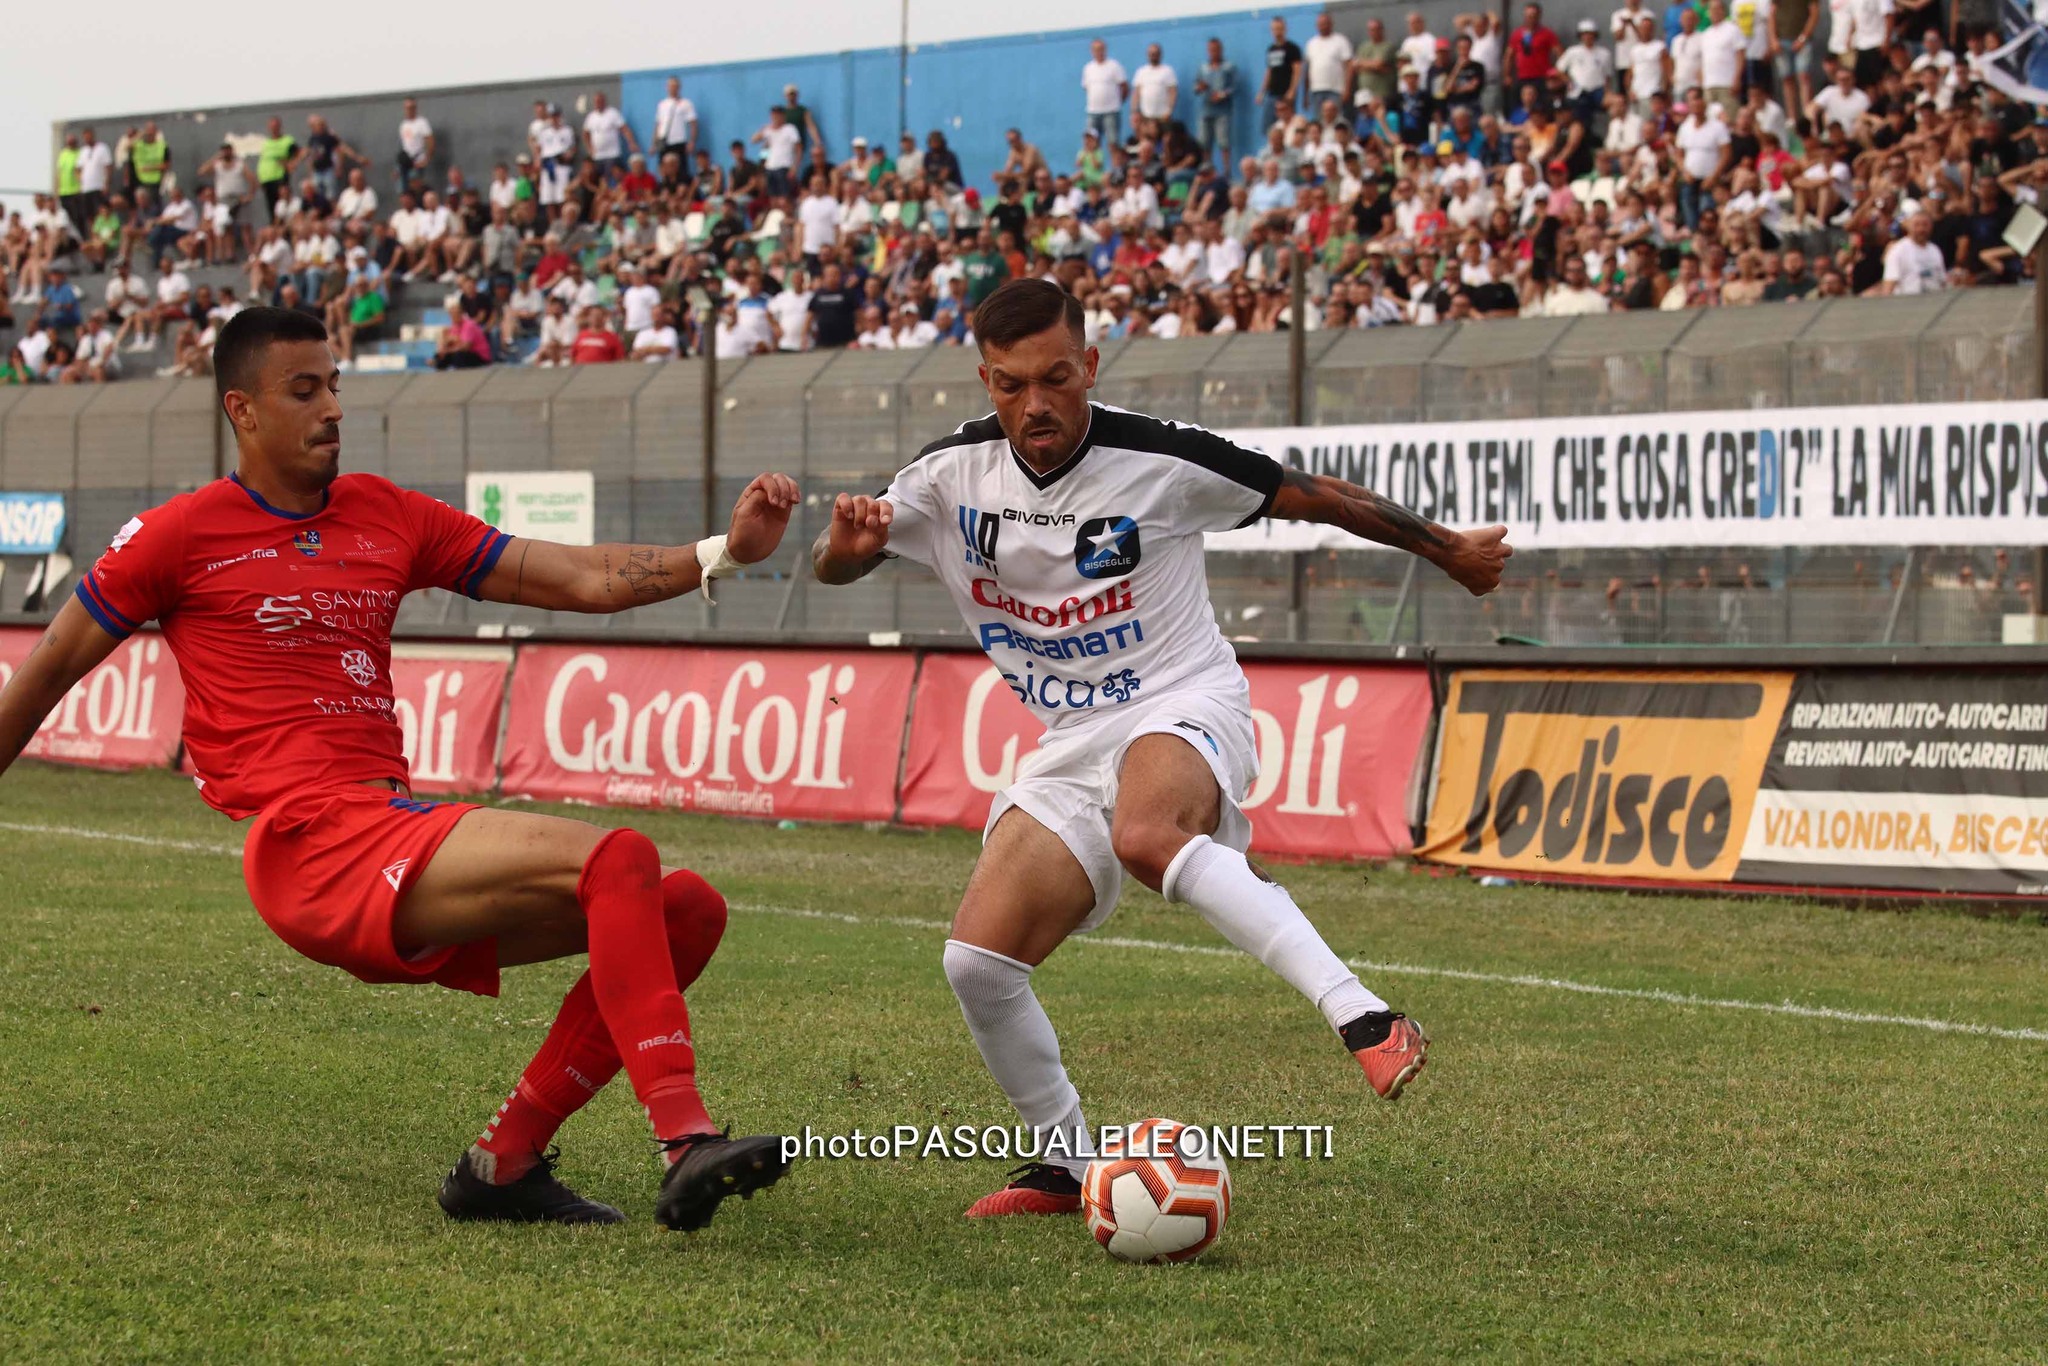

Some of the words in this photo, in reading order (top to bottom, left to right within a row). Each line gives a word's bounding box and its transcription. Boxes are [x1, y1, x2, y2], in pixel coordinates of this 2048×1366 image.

[1388, 440, 1457, 523] COSA
[1467, 438, 1542, 535] TEMI,
[1553, 437, 1606, 521] CHE
[1617, 433, 1691, 520] COSA
[1833, 427, 1867, 517] LA
[1880, 426, 1934, 517] MIA
[1003, 508, 1075, 526] GIVOVA
[1084, 557, 1132, 571] BISCEGLIE
[545, 653, 855, 789] Carofoli
[1791, 702, 1894, 729] RIPARAZIONI
[1784, 740, 1861, 767] REVISIONI
[1457, 681, 1763, 870] Todisco
[1764, 808, 1811, 848] VIA
[1816, 809, 1940, 858] LONDRA,
